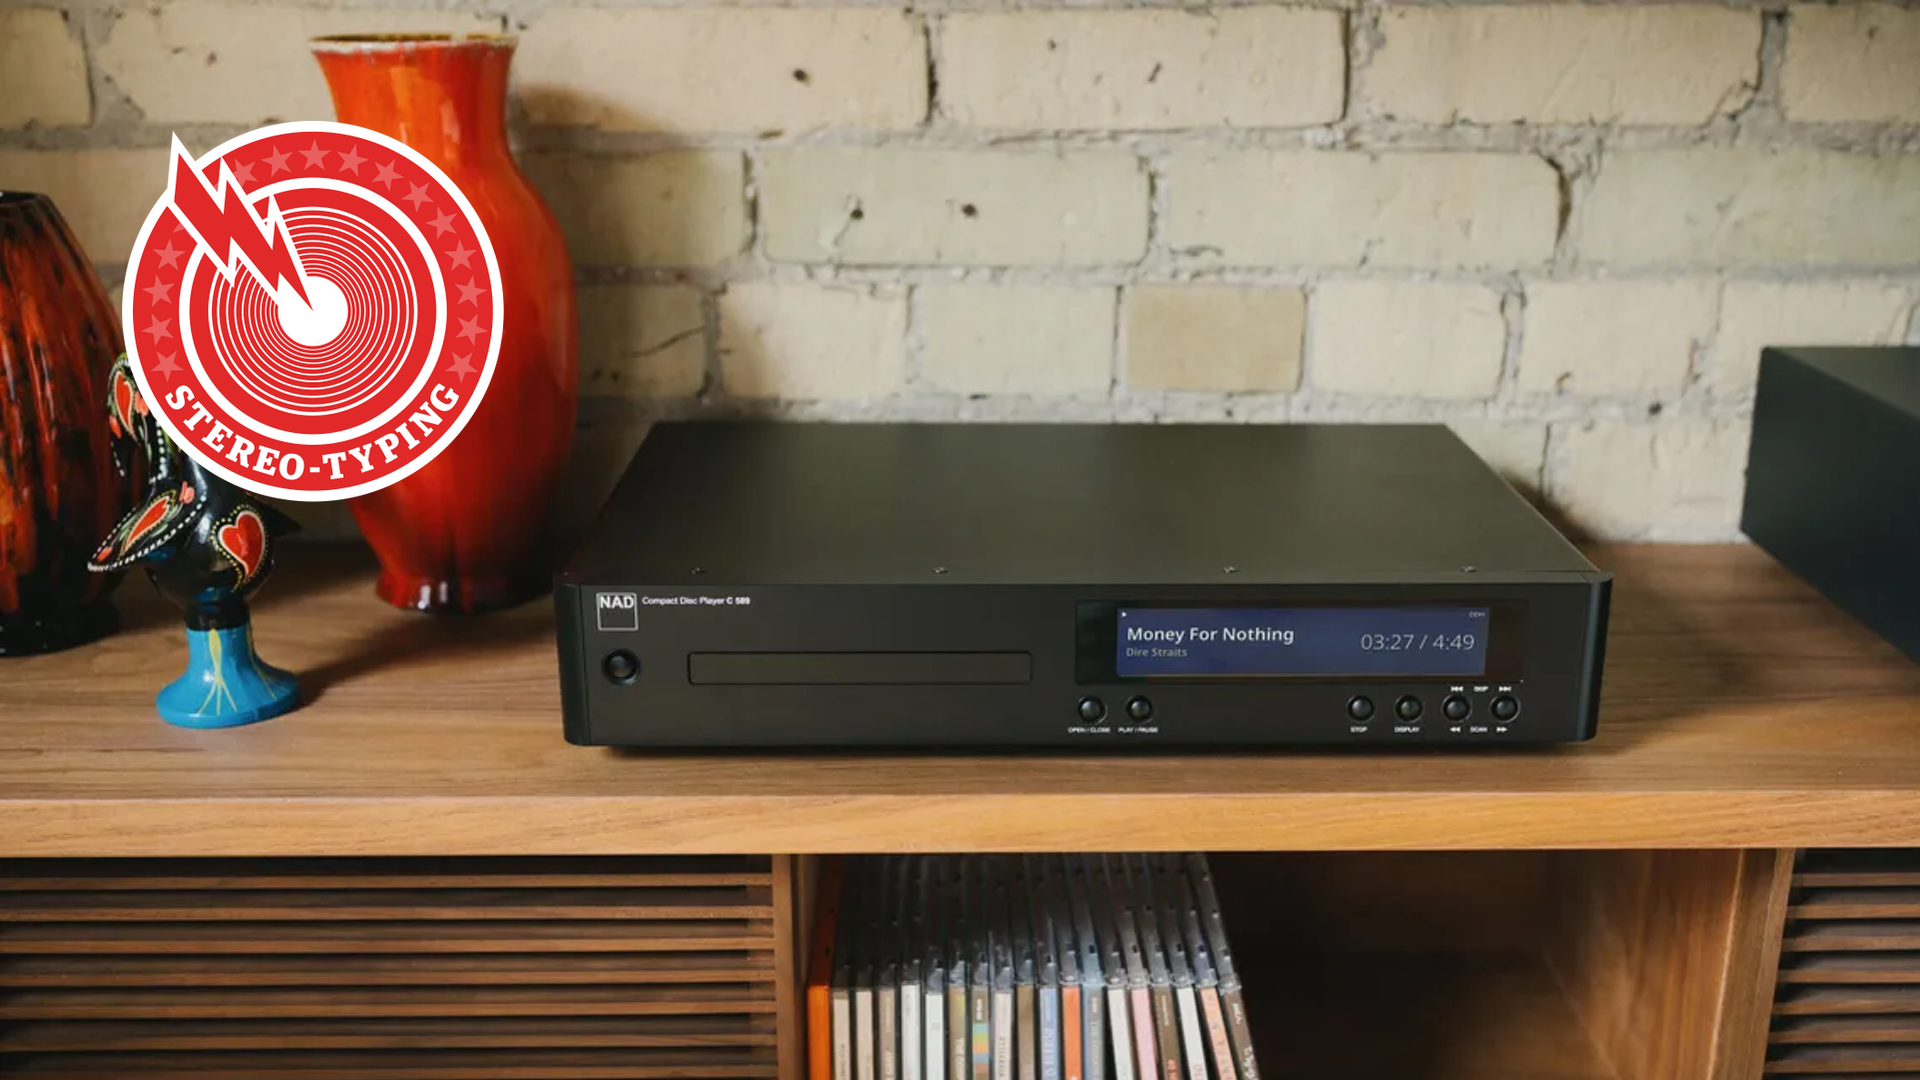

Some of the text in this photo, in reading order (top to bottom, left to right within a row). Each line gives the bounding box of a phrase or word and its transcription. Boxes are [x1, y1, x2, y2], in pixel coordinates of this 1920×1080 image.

[600, 596, 634, 609] NAD
[641, 596, 678, 606] Compact
[680, 596, 697, 605] Disc
[699, 596, 725, 606] Player
[735, 596, 750, 605] 589
[1127, 627, 1294, 646] Money For Nothing
[1361, 634, 1415, 650] 03:27
[1432, 634, 1475, 650] 4:49
[1126, 647, 1188, 657] Dire Straits
